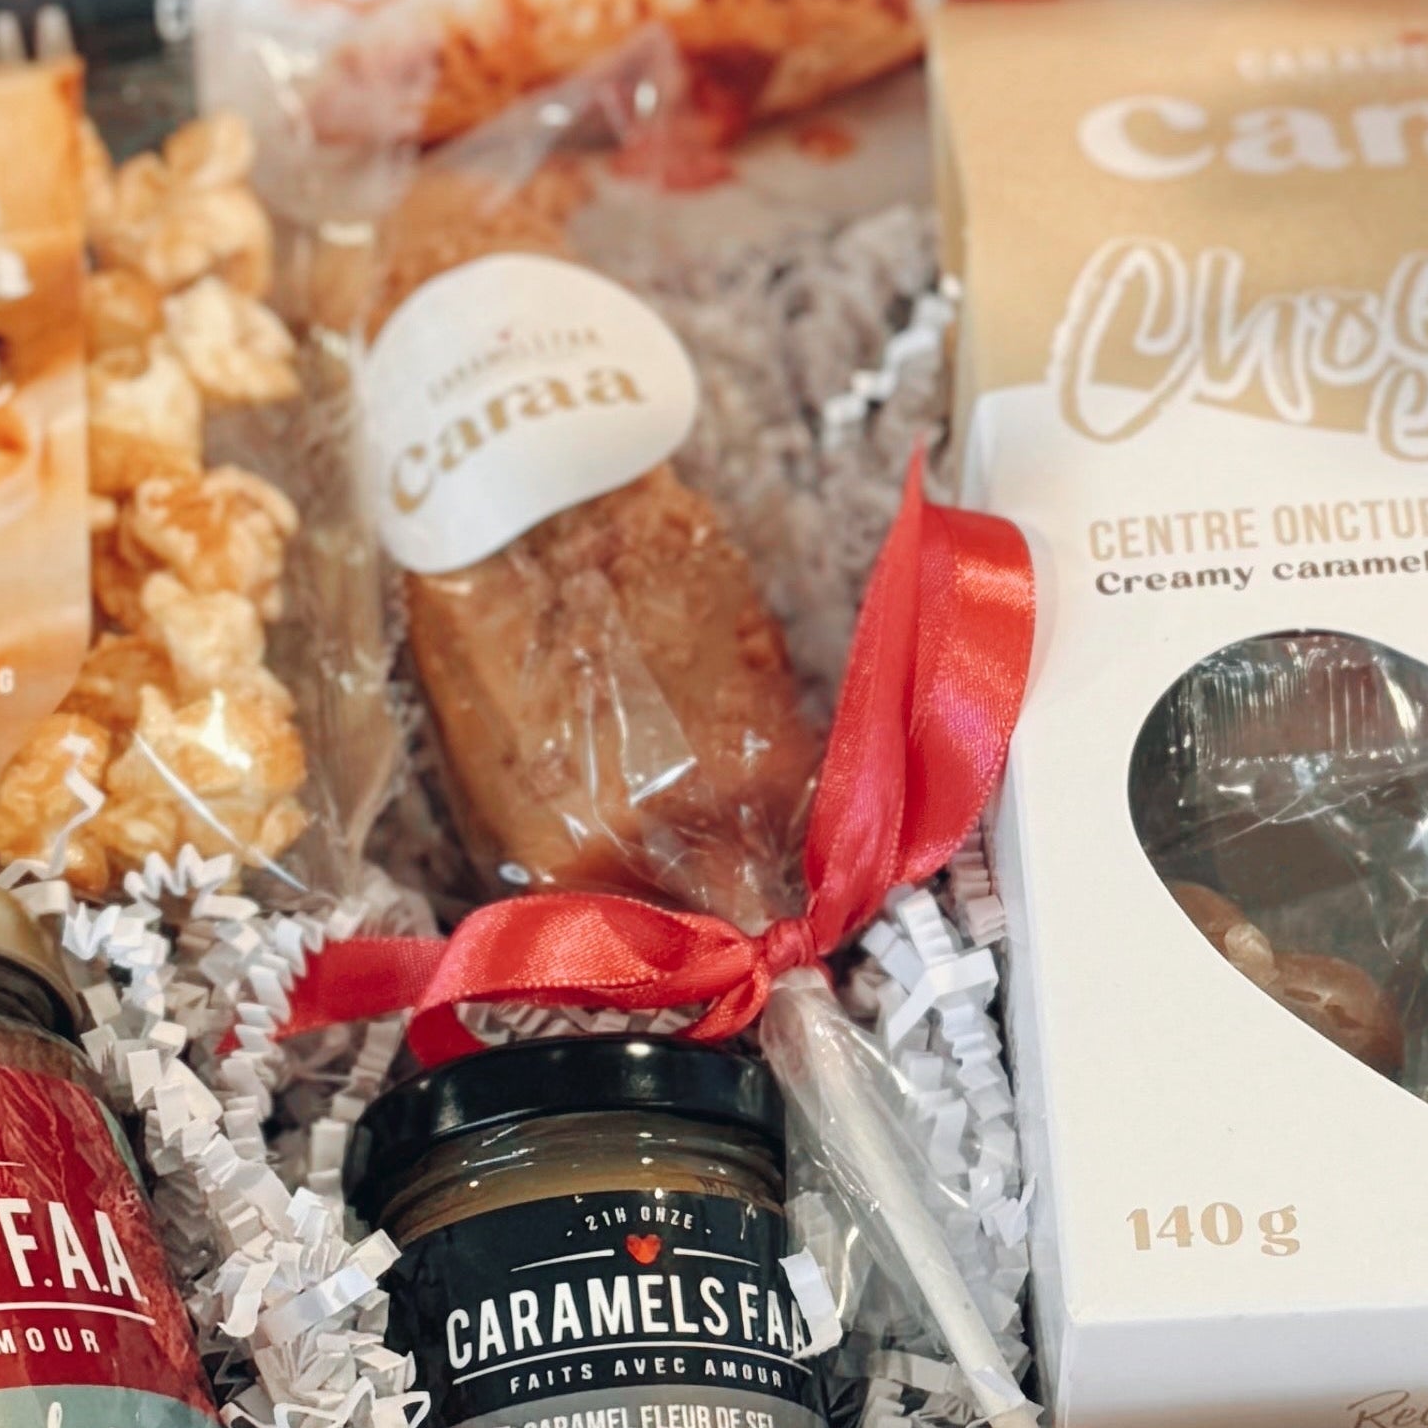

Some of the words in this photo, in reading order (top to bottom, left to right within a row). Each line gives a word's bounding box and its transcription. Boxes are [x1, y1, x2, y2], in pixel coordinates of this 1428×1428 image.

[391, 369, 648, 515] Caraa
[1087, 507, 1259, 563] CENTRE
[1094, 566, 1255, 598] Creamy
[585, 1207, 627, 1232] 21H
[640, 1205, 694, 1231] ONZE
[1125, 1201, 1244, 1252] 140
[1258, 1204, 1302, 1257] g
[446, 1274, 729, 1369] CARAMELS
[510, 1365, 594, 1394] FAITS
[614, 1357, 686, 1377] AVEC
[704, 1358, 783, 1389] AMOUR
